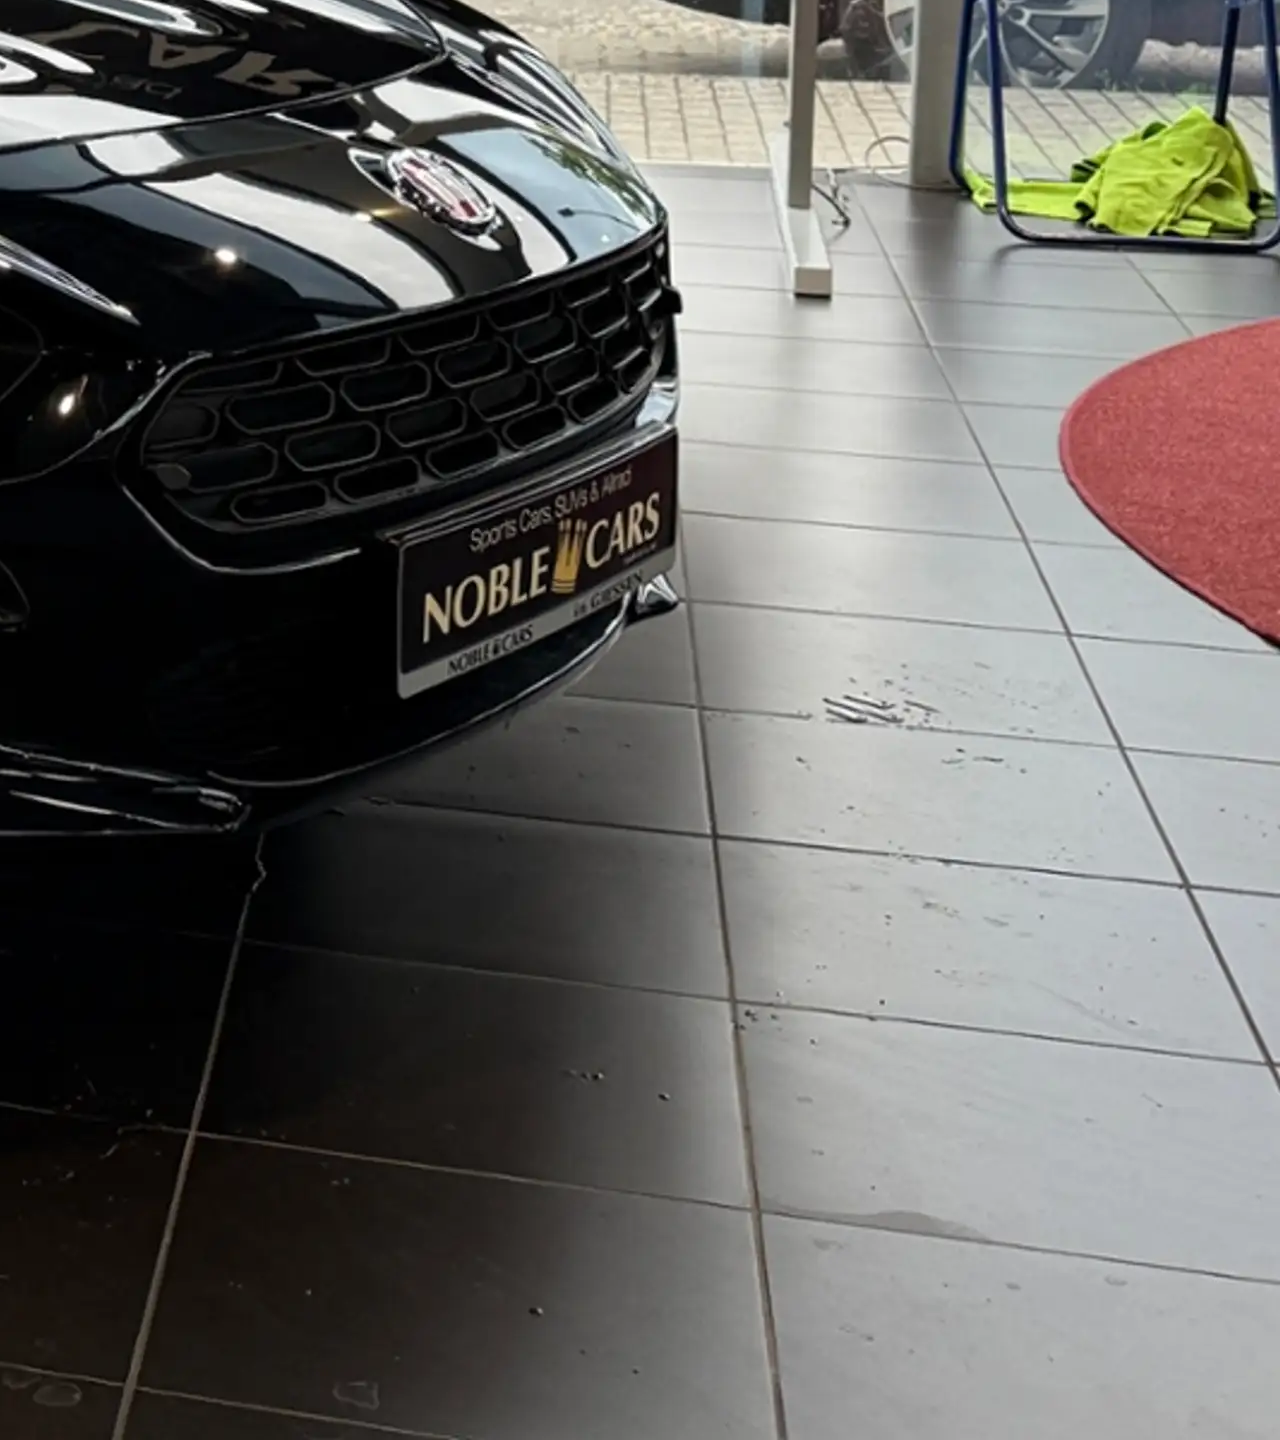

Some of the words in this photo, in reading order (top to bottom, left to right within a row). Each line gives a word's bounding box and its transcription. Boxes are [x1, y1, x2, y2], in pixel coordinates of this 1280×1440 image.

[468, 517, 518, 553] Sports
[421, 545, 552, 645] NOBLE
[585, 491, 661, 569] CARS
[446, 640, 491, 676] NOBLE
[501, 623, 534, 652] CARS
